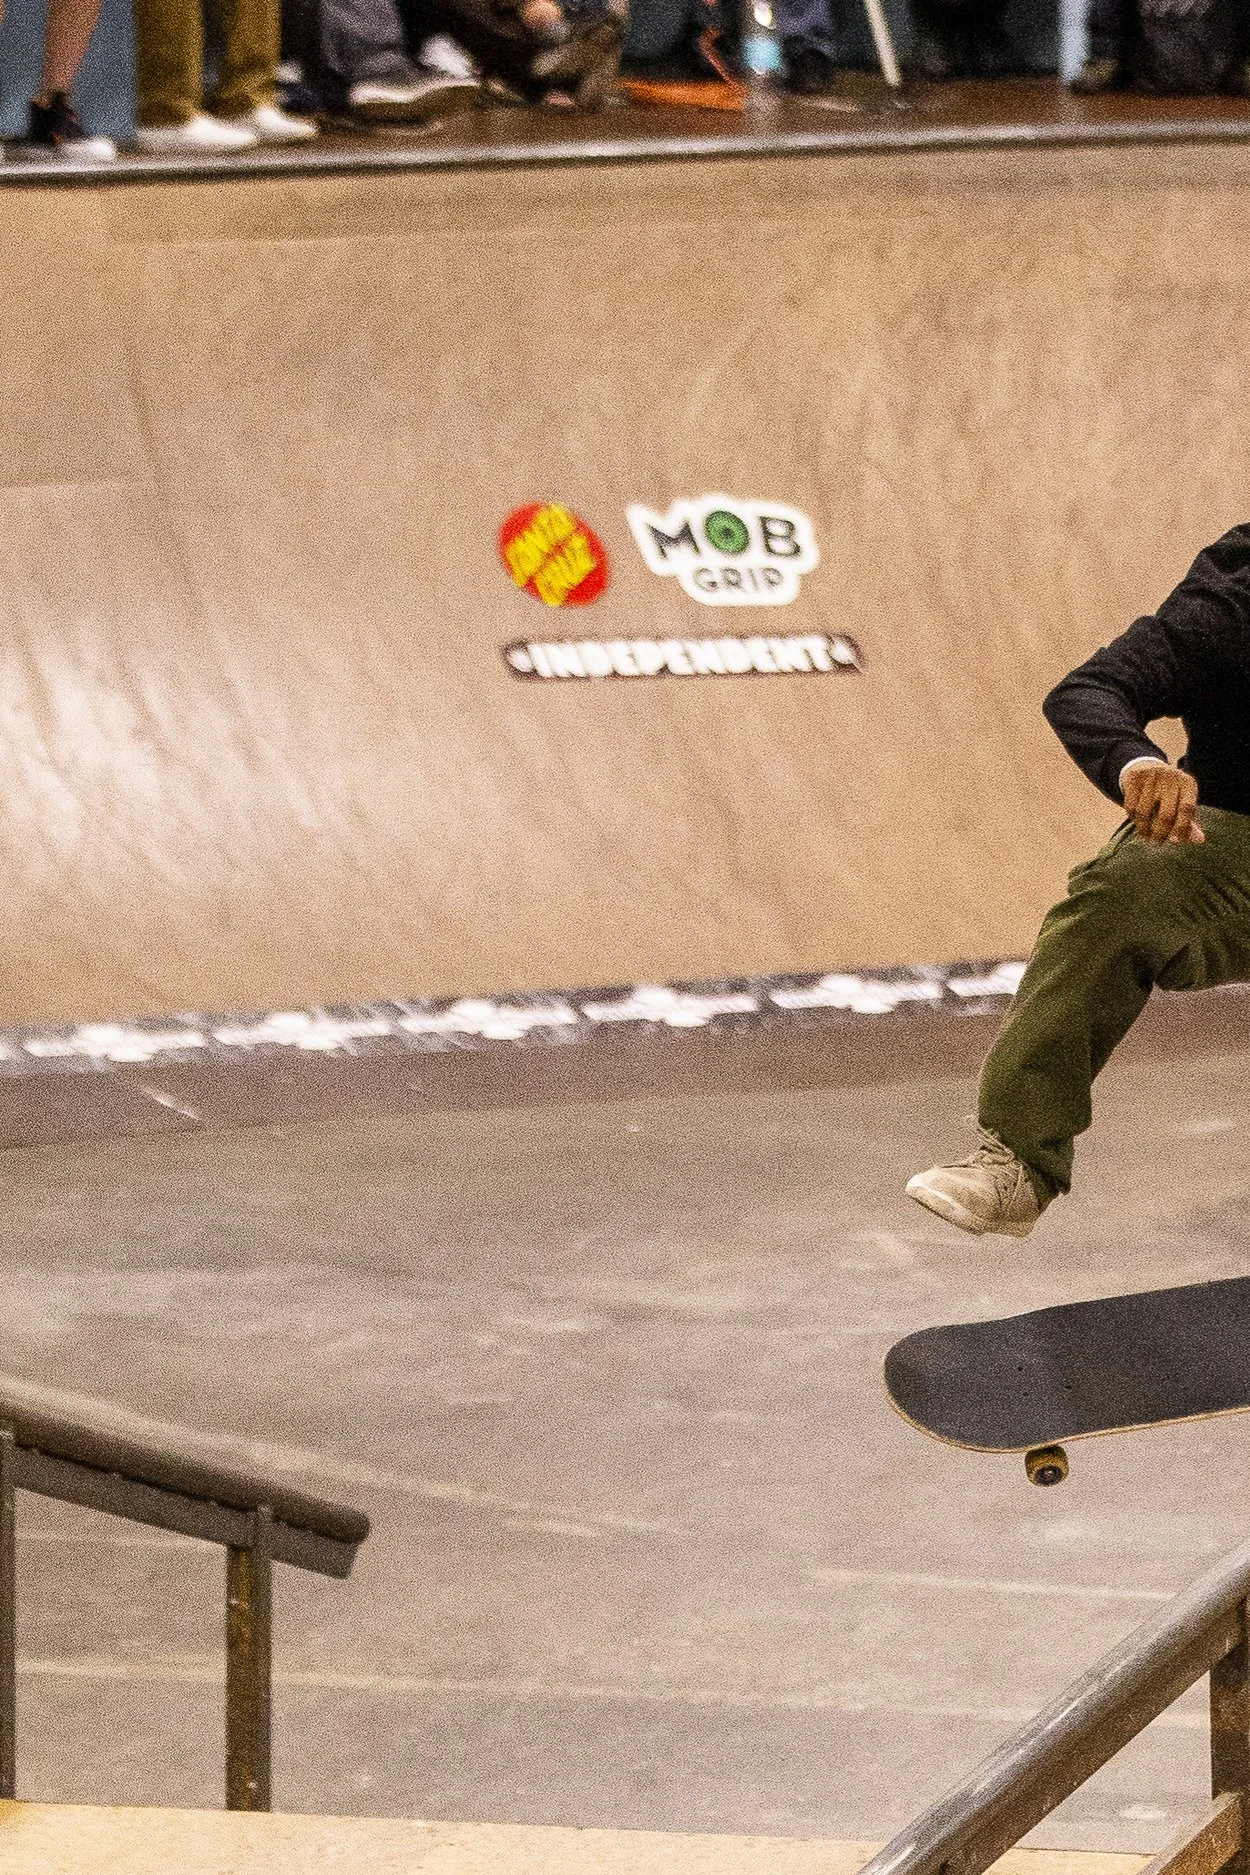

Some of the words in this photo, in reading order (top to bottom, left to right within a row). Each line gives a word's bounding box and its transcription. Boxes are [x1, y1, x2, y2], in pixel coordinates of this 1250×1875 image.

[645, 509, 801, 560] MOB
[692, 566, 784, 593] GRIP
[527, 635, 833, 679] INDEPENDENT
